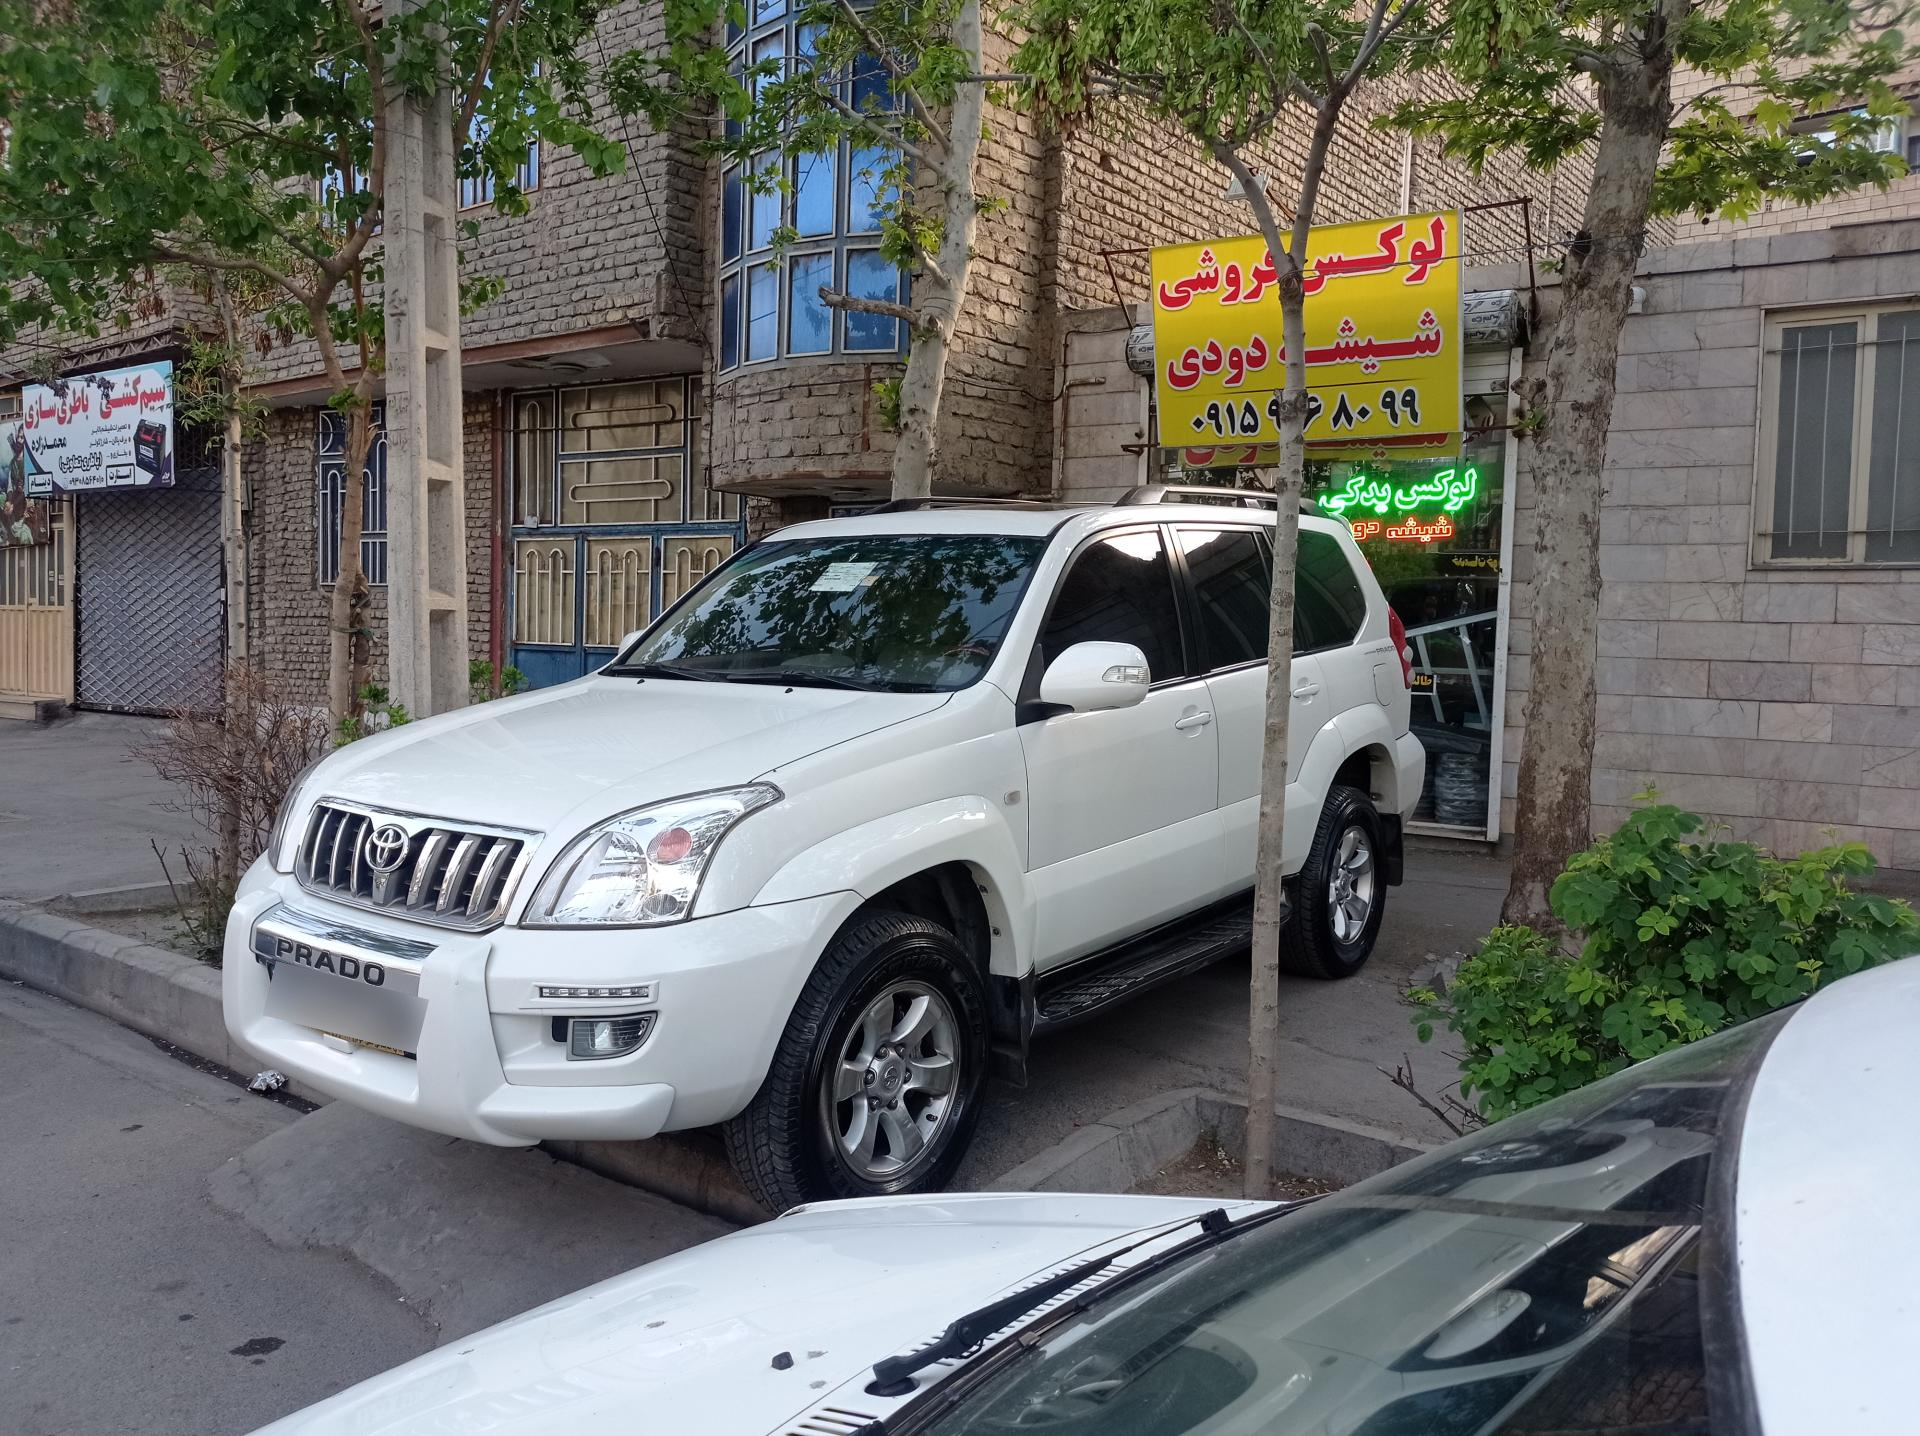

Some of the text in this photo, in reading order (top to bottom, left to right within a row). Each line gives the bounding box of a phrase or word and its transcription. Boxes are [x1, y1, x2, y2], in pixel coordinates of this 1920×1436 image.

[1304, 217, 1446, 295] لوکس
[1167, 336, 1269, 390] دودی
[1278, 309, 1442, 374] شیش
[24, 394, 57, 429] سازی
[1267, 396, 1323, 432] ۹۶
[1318, 467, 1478, 515] لوکس یدکی
[1350, 515, 1453, 542] شیشه دو
[275, 937, 386, 987] PRADO
